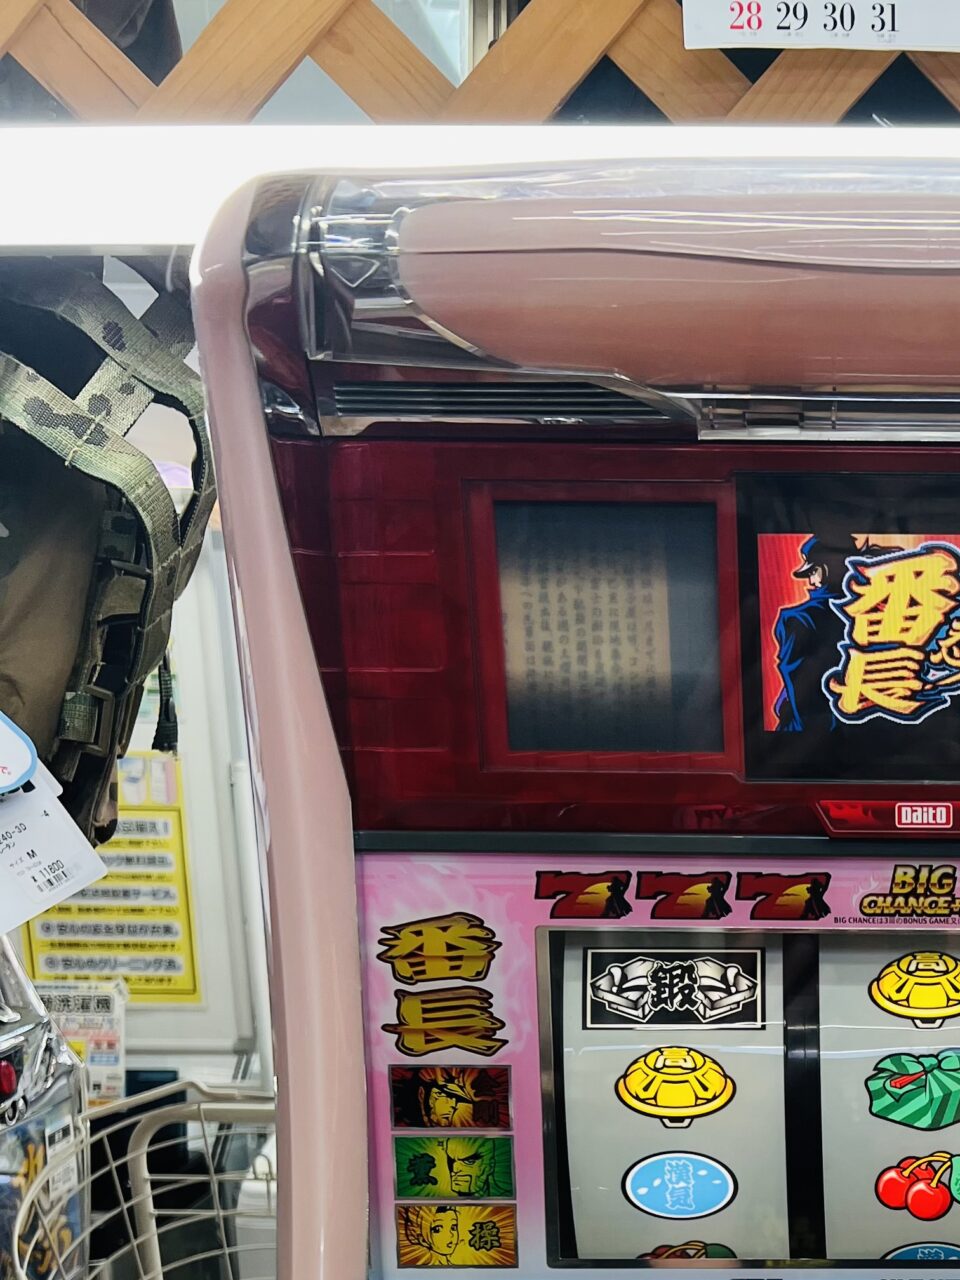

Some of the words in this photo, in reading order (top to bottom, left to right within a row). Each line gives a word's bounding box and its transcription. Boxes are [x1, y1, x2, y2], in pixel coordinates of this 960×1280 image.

[729, 1, 763, 31] 28
[776, 1, 809, 31] 29
[823, 1, 856, 32] 30
[871, 2, 900, 33] 31
[26, 848, 38, 860] M
[891, 864, 957, 895] BIG
